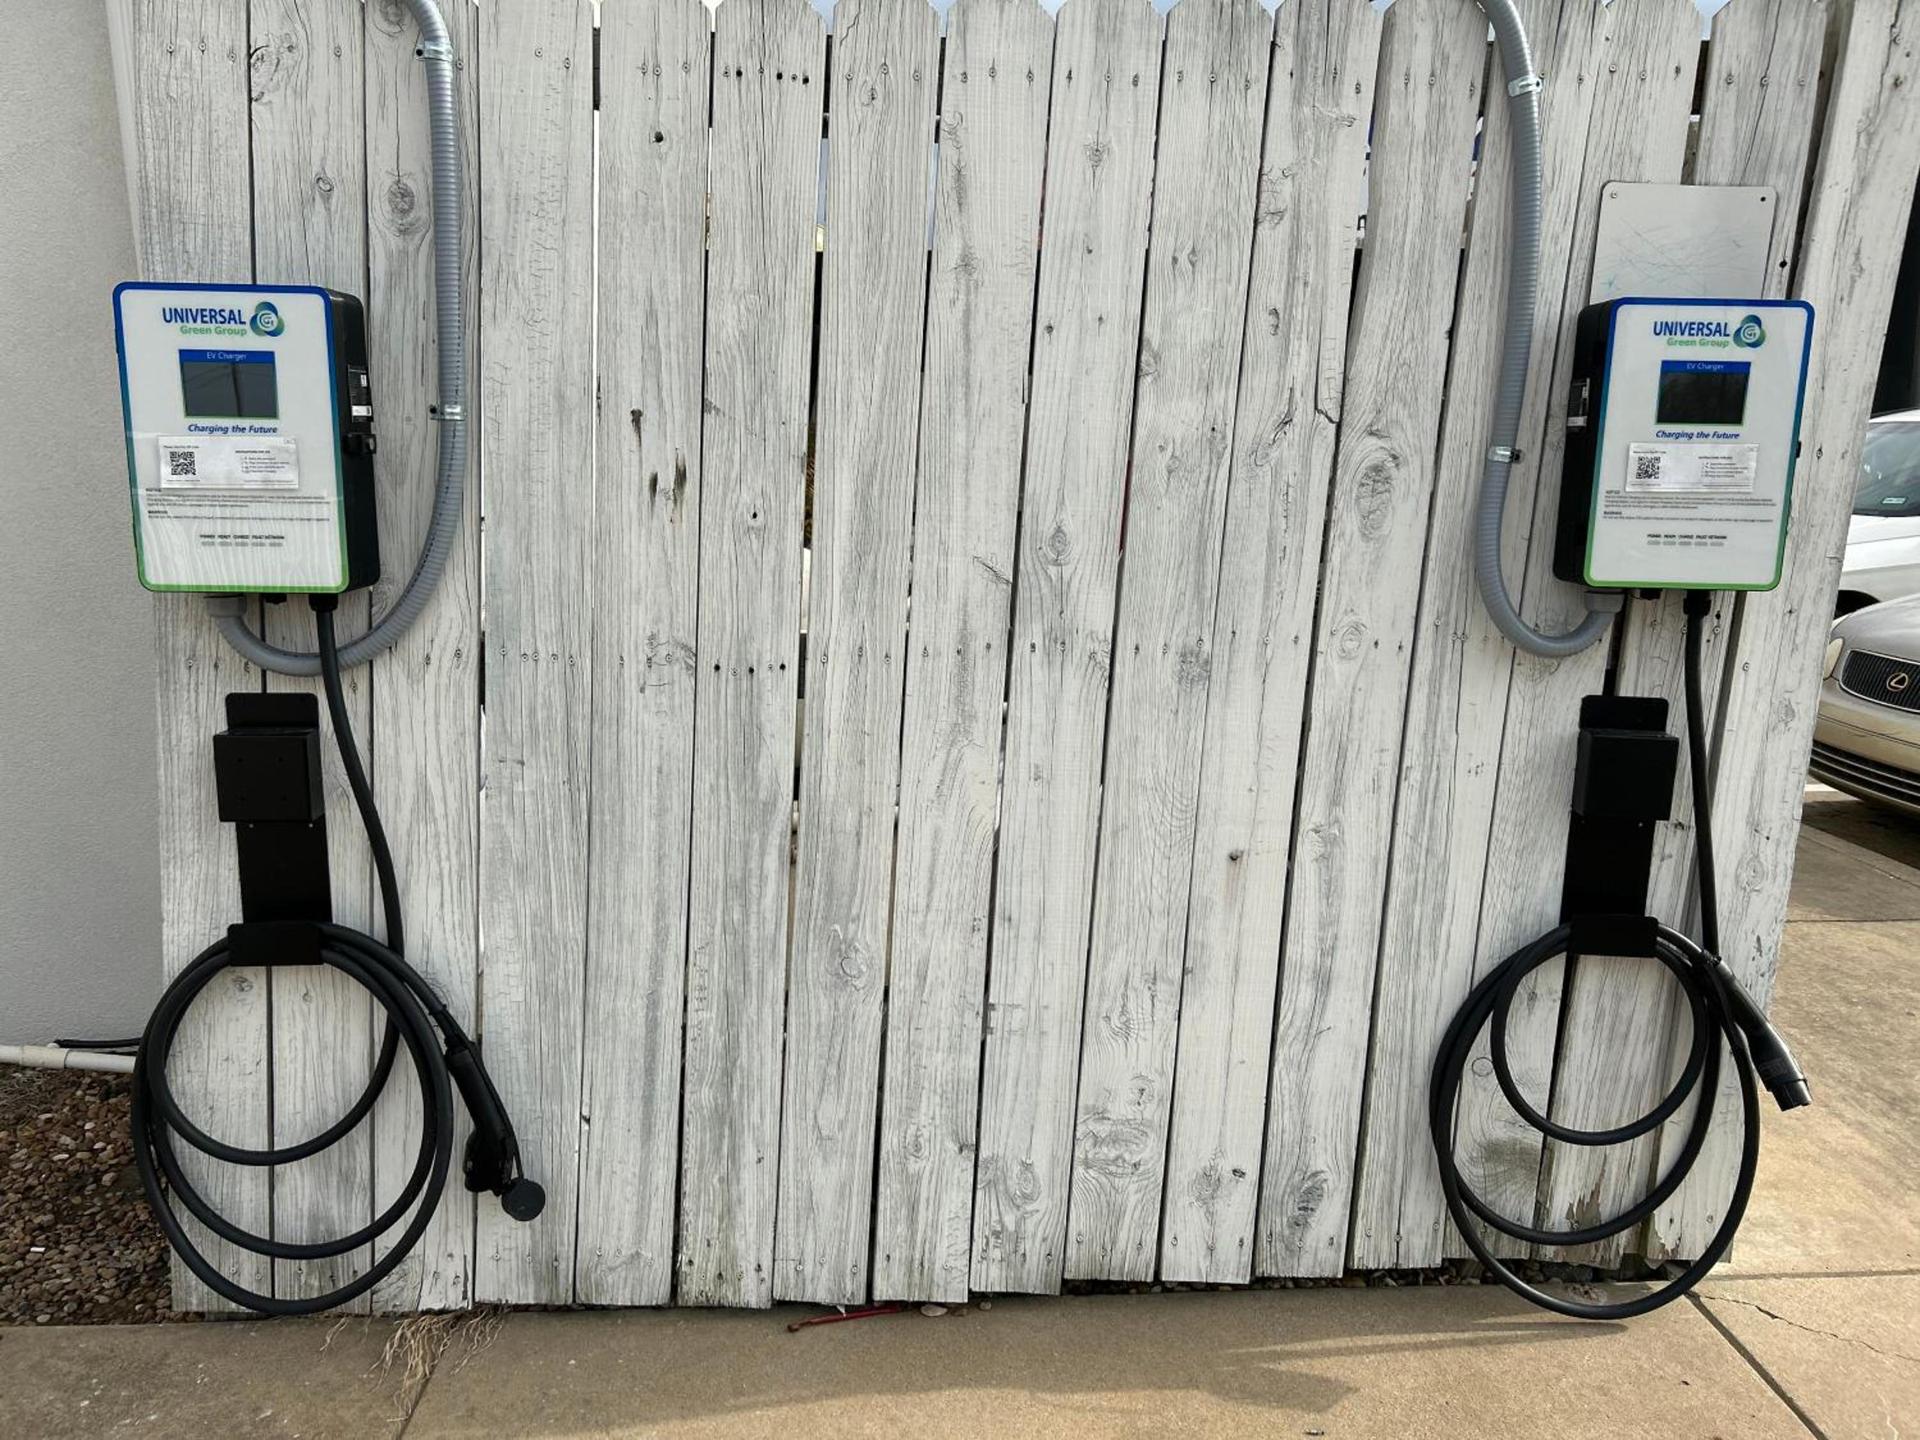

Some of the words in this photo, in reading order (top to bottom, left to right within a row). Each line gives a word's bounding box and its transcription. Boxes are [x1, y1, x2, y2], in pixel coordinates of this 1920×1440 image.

[162, 307, 247, 325] UNIVERSAL
[180, 325, 212, 335] Green
[214, 326, 247, 337] Group
[1653, 321, 1730, 337] UNIVERSAL
[1667, 338, 1697, 347] Green
[1699, 338, 1729, 348] Group
[217, 351, 247, 362] Charger
[188, 424, 229, 435] Charging
[231, 424, 247, 433] the
[249, 424, 278, 434] Future
[1655, 430, 1694, 441] Charging
[1696, 431, 1710, 439] the
[1712, 431, 1740, 440] Future
